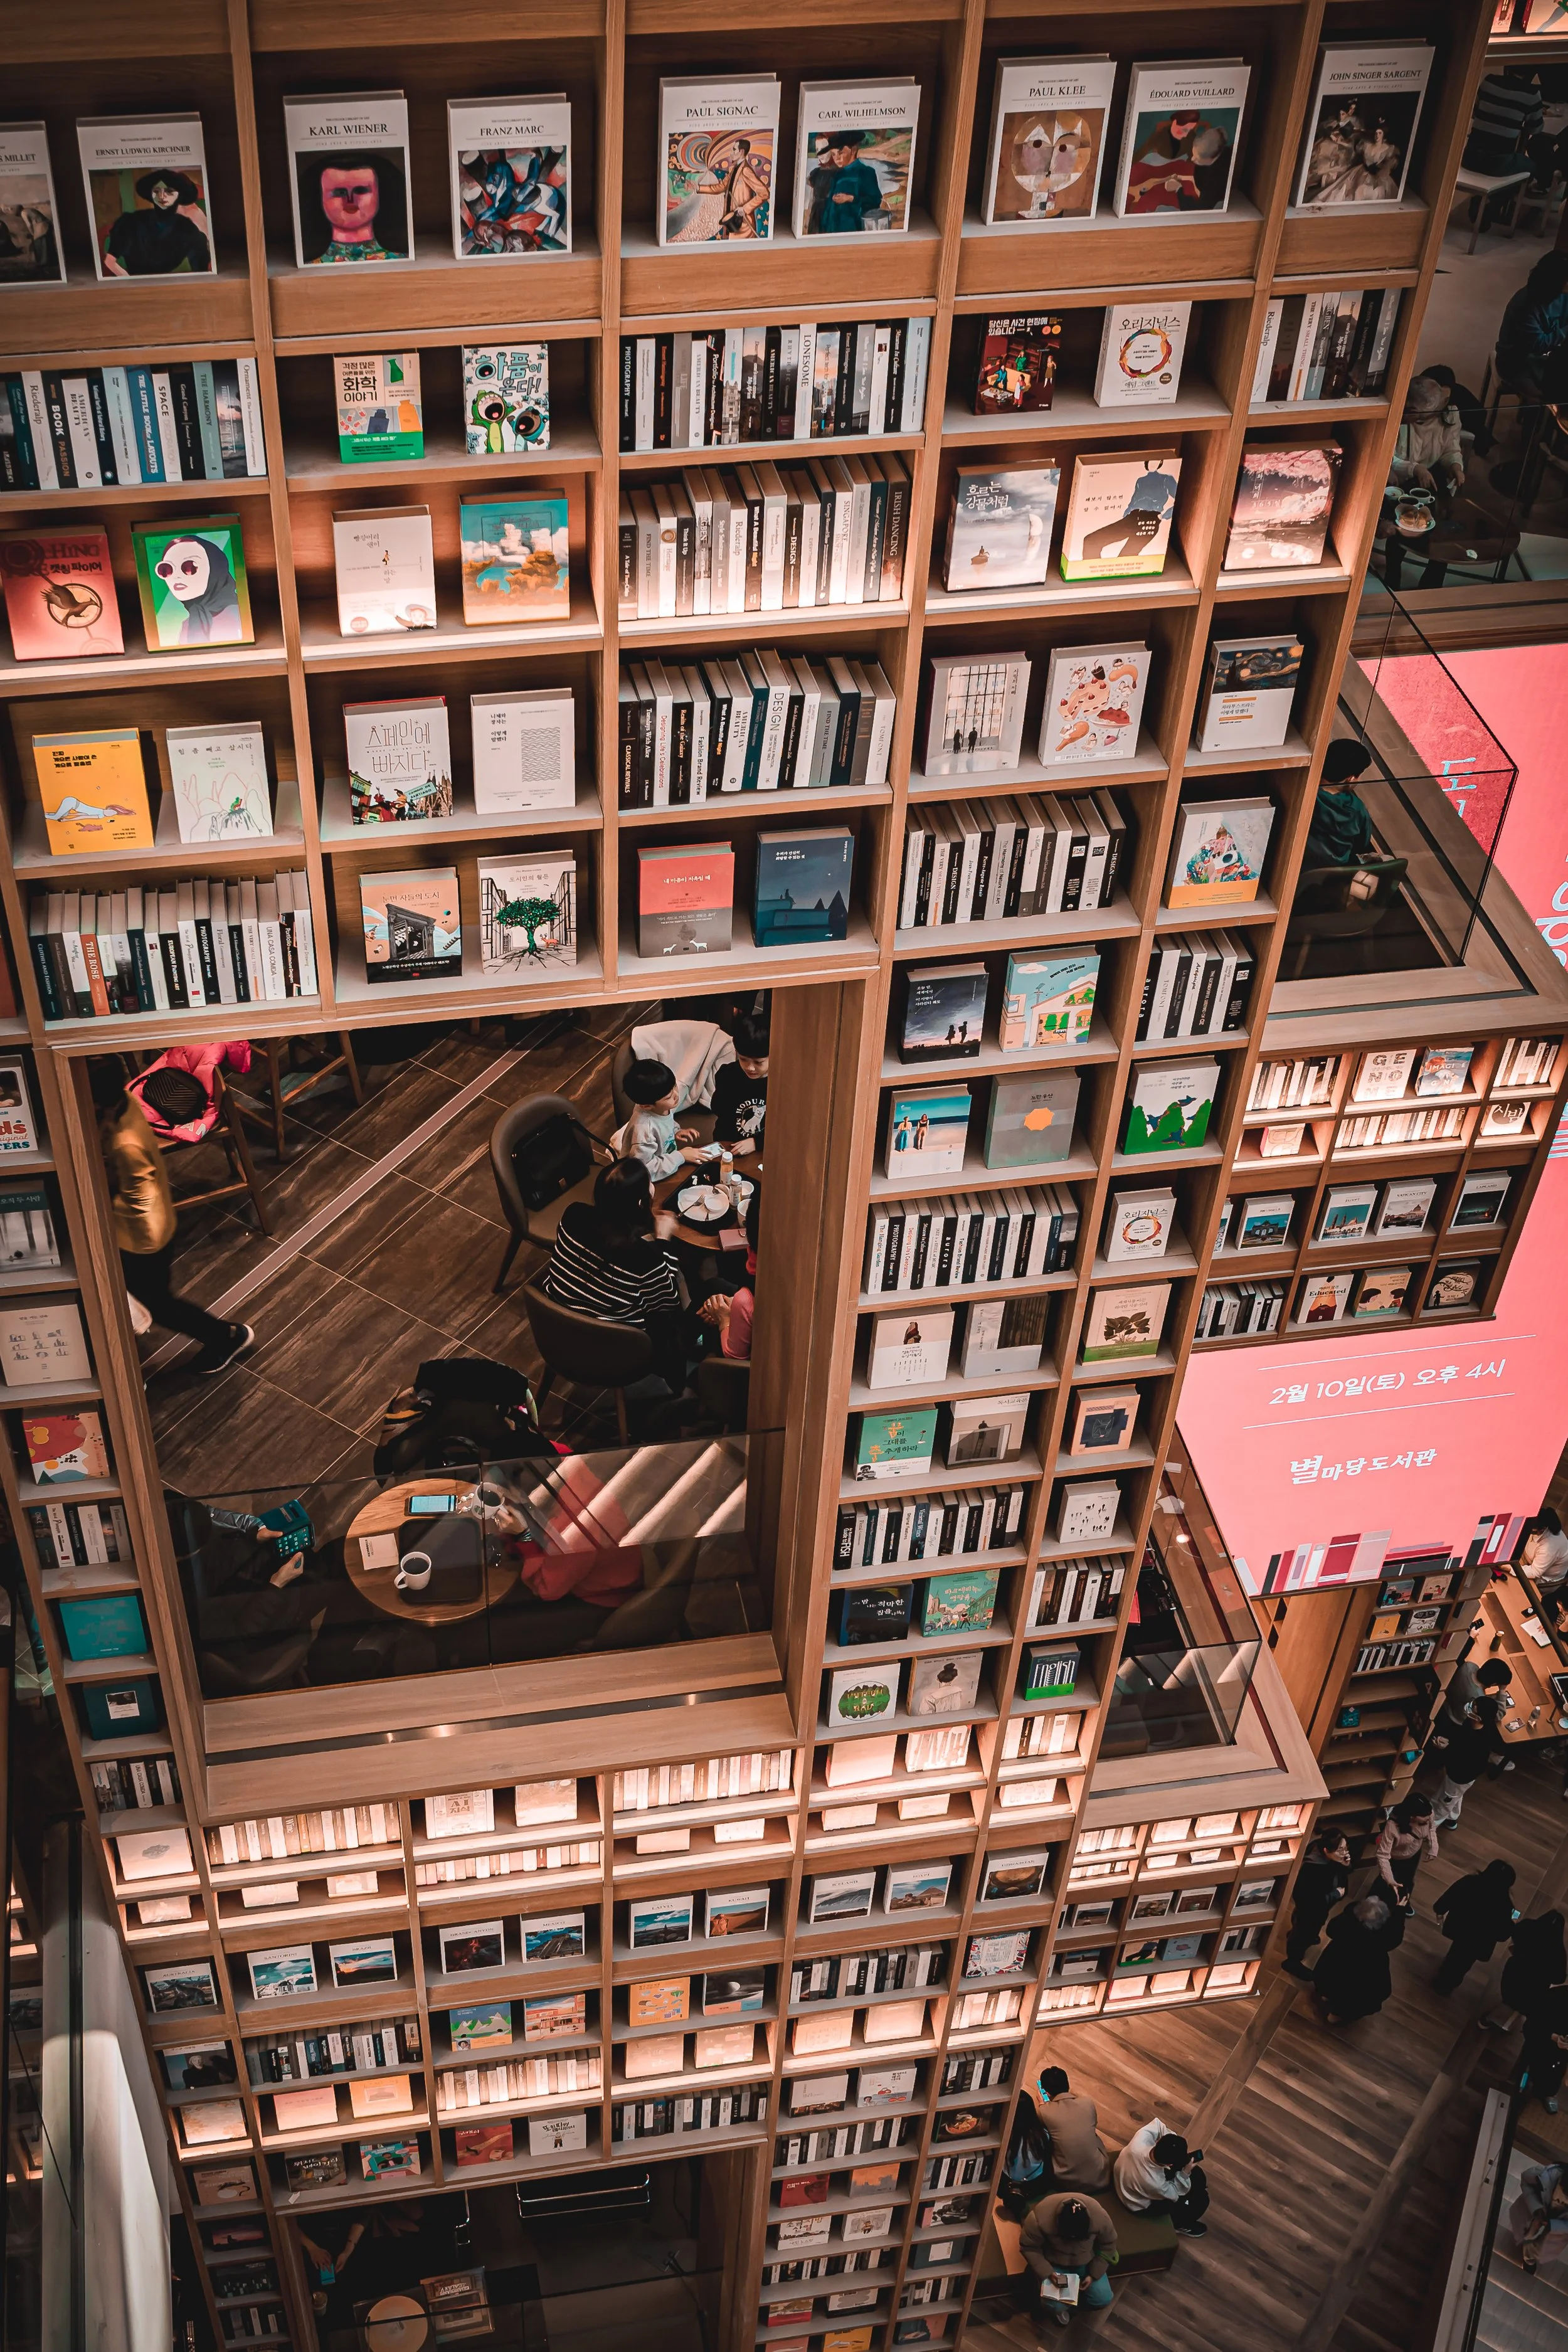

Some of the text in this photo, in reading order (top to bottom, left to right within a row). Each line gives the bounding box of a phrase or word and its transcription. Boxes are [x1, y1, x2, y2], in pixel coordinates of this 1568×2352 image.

[1330, 69, 1422, 81] JOHN SINGER SARGENT
[1029, 85, 1086, 97] PAUL KLEE
[1149, 87, 1235, 99] ÉDOUARD VUILLARD
[686, 105, 758, 117] PAUL SIGNAC
[818, 107, 906, 120] CARL WILHELMSON
[309, 123, 388, 136] KARL WIENER
[480, 125, 544, 136] FRANZ MARC
[3, 153, 36, 162] MILLET
[95, 146, 191, 157] ERNST LUDWIG KIRCHNER
[988, 317, 1048, 328] 당신은 사건 현장에
[988, 327, 1016, 336] 있습니다
[1119, 315, 1181, 331] 오리지널스
[1261, 311, 1276, 346] Riederalp
[1306, 314, 1315, 329] VERY
[1303, 330, 1311, 347] SMALL
[475, 352, 542, 381] 하품이
[801, 334, 812, 388] LONESOME
[1299, 349, 1308, 367] THING
[342, 376, 378, 391] 화학
[499, 377, 541, 397] 온다!
[29, 384, 44, 425] Riederalp
[200, 374, 213, 426] THE HARMONY
[344, 391, 378, 403] 이야기
[70, 393, 80, 426] BEAUTY
[78, 393, 90, 437] AMERICAN
[158, 386, 176, 464] SPACE DECORATION
[51, 405, 70, 477] BOOK PASSION
[966, 481, 1002, 497] 흐르는
[964, 494, 1009, 512] 강물처럼
[841, 501, 850, 542] SINGAPORE
[889, 491, 903, 556] IRISH DANCING
[733, 521, 743, 556] Riederalp
[665, 548, 673, 571] Heritage
[644, 708, 652, 731] Tuesdays
[770, 692, 785, 731] DESIGN
[365, 718, 431, 749] 스페인에
[733, 710, 741, 739] BEAUTY
[738, 711, 748, 748] AMERICAN
[658, 715, 667, 788] Designing Life's Celebrations
[372, 750, 430, 774] 빠지다
[999, 849, 1007, 869] Harmony
[1109, 853, 1118, 874] DESIGN
[950, 867, 958, 889] DESIGN
[425, 891, 440, 900] 도시
[38, 943, 46, 964] CLOTHES
[44, 975, 53, 995] FASHION
[85, 941, 100, 980] THE ROSE
[1191, 962, 1201, 990] Arequipa
[1138, 978, 1151, 1018] aurora
[876, 1234, 884, 1252] Hanging
[889, 1224, 900, 1261] PHOTOGRAPHY
[906, 1227, 914, 1246] Designing
[942, 1236, 951, 1268] aurora
[1309, 1288, 1347, 1296] Educated
[1268, 1359, 1507, 1405] 2월 10일(토) 오후 4시
[882, 1438, 908, 1447] 그대를
[901, 1444, 919, 1453] 하라
[34, 1512, 43, 1523] ONCE
[840, 1543, 851, 1557] FISH
[1032, 1659, 1076, 1689] English
[450, 1806, 470, 1814] 지식
[451, 1799, 469, 1808] AI
[285, 1818, 294, 1833] Wine
